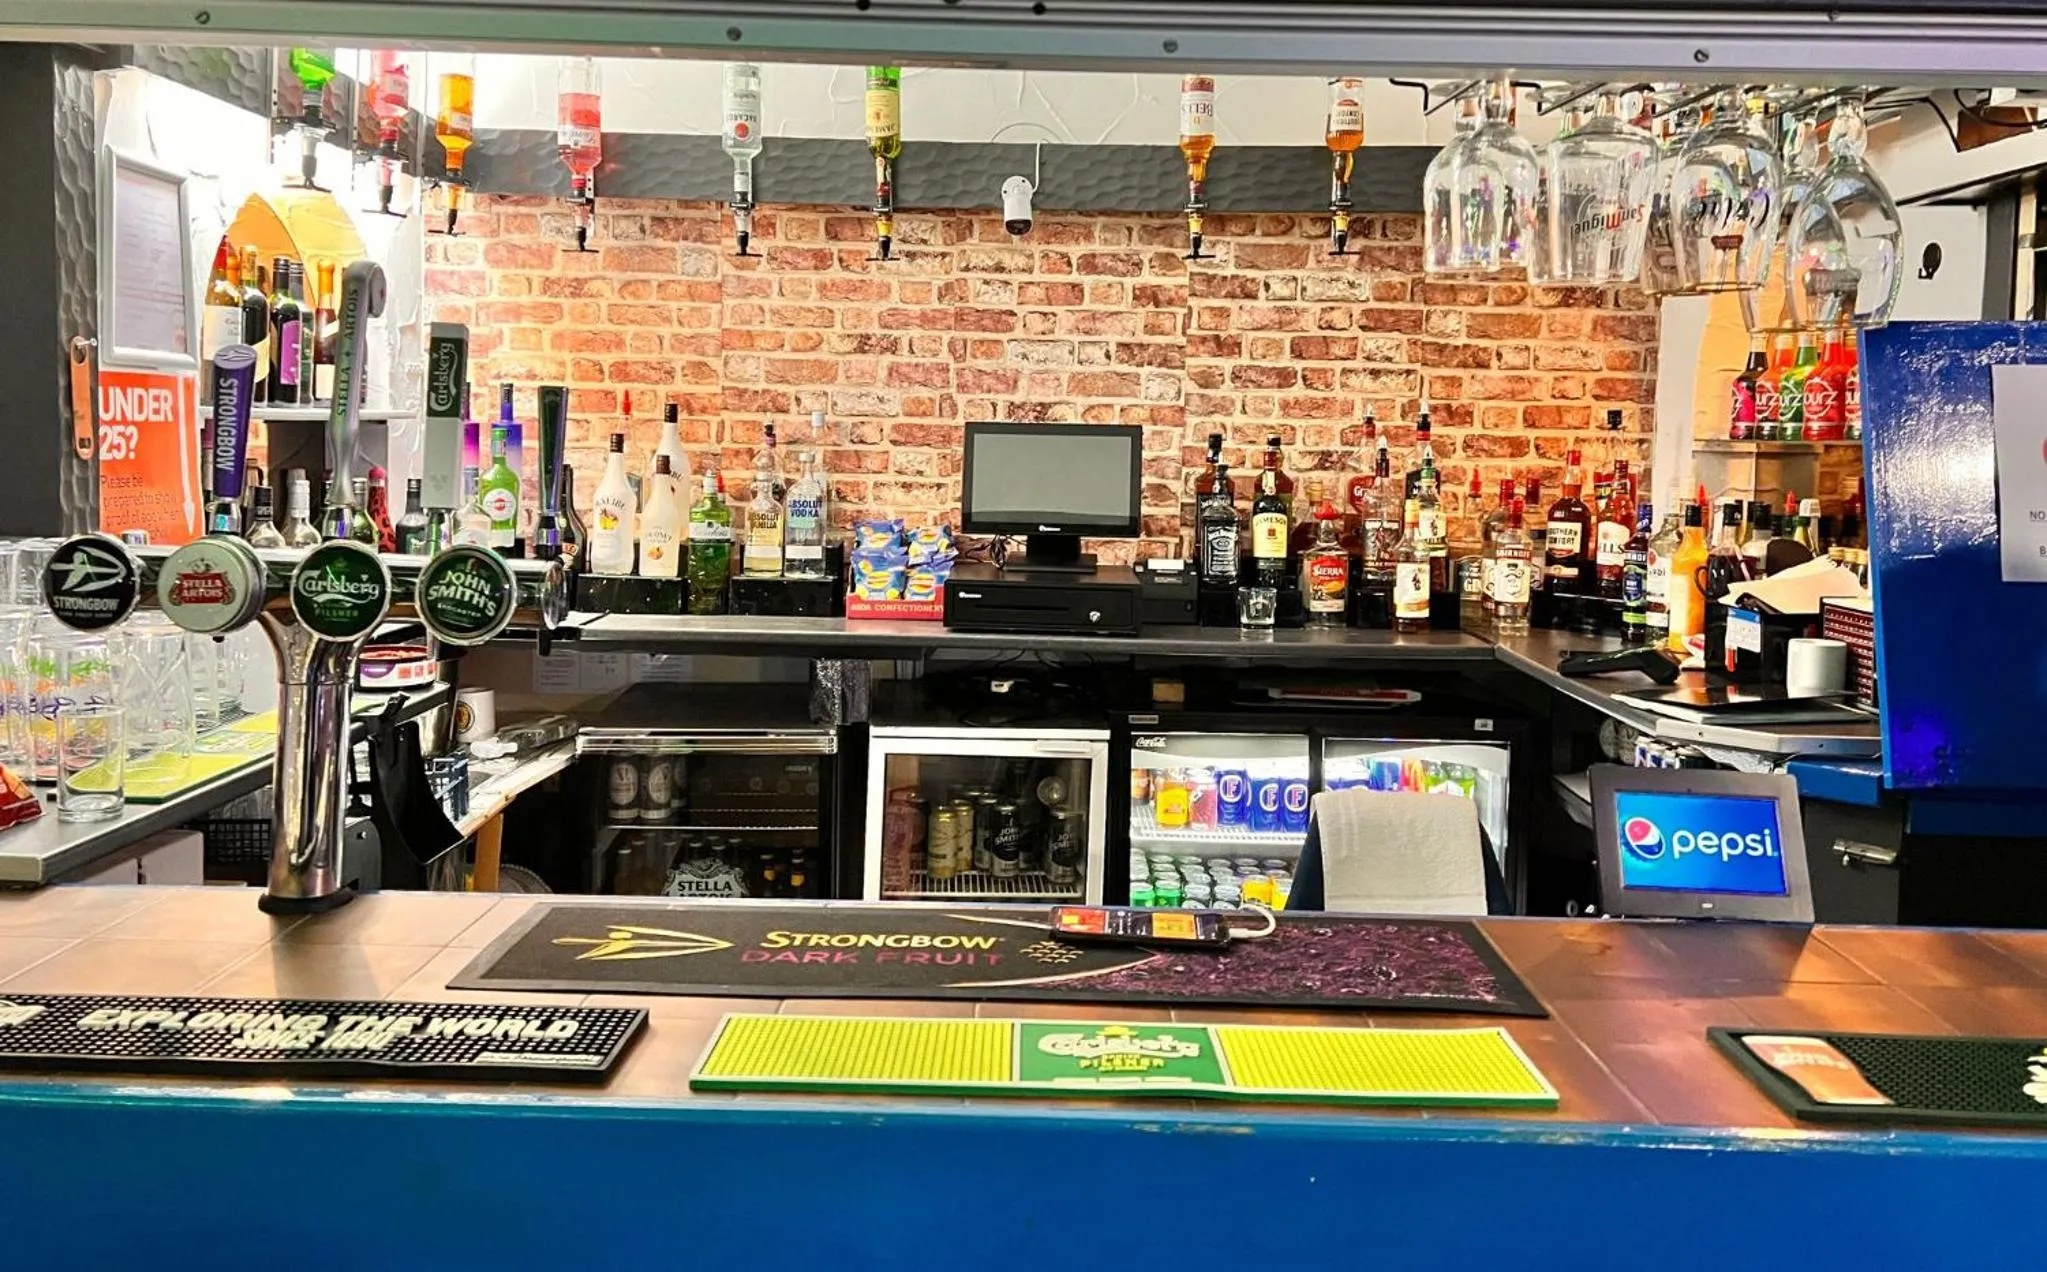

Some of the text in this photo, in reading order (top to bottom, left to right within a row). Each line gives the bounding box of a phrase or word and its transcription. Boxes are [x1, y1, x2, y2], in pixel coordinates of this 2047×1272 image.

[336, 289, 358, 416] STELLA ARTOIS
[429, 342, 455, 412] Carlsberg
[98, 386, 174, 423] UNDER
[216, 378, 239, 472] STRONGBOW
[98, 425, 139, 461] 25?
[790, 508, 820, 518] VODKA
[181, 588, 223, 598] ARTOIS
[182, 579, 223, 588] STELLA
[299, 569, 381, 603] Carlsberg
[439, 570, 491, 595] JOHN
[53, 595, 120, 612] STRONGBOW
[427, 585, 497, 617] SMITH'S
[1672, 828, 1774, 863] pepsi
[678, 881, 733, 892] STELLA
[759, 930, 998, 949] STRONGBOW
[739, 950, 1004, 966] DARK FRUIT
[77, 1008, 580, 1041] EXPLORING THE WORLD
